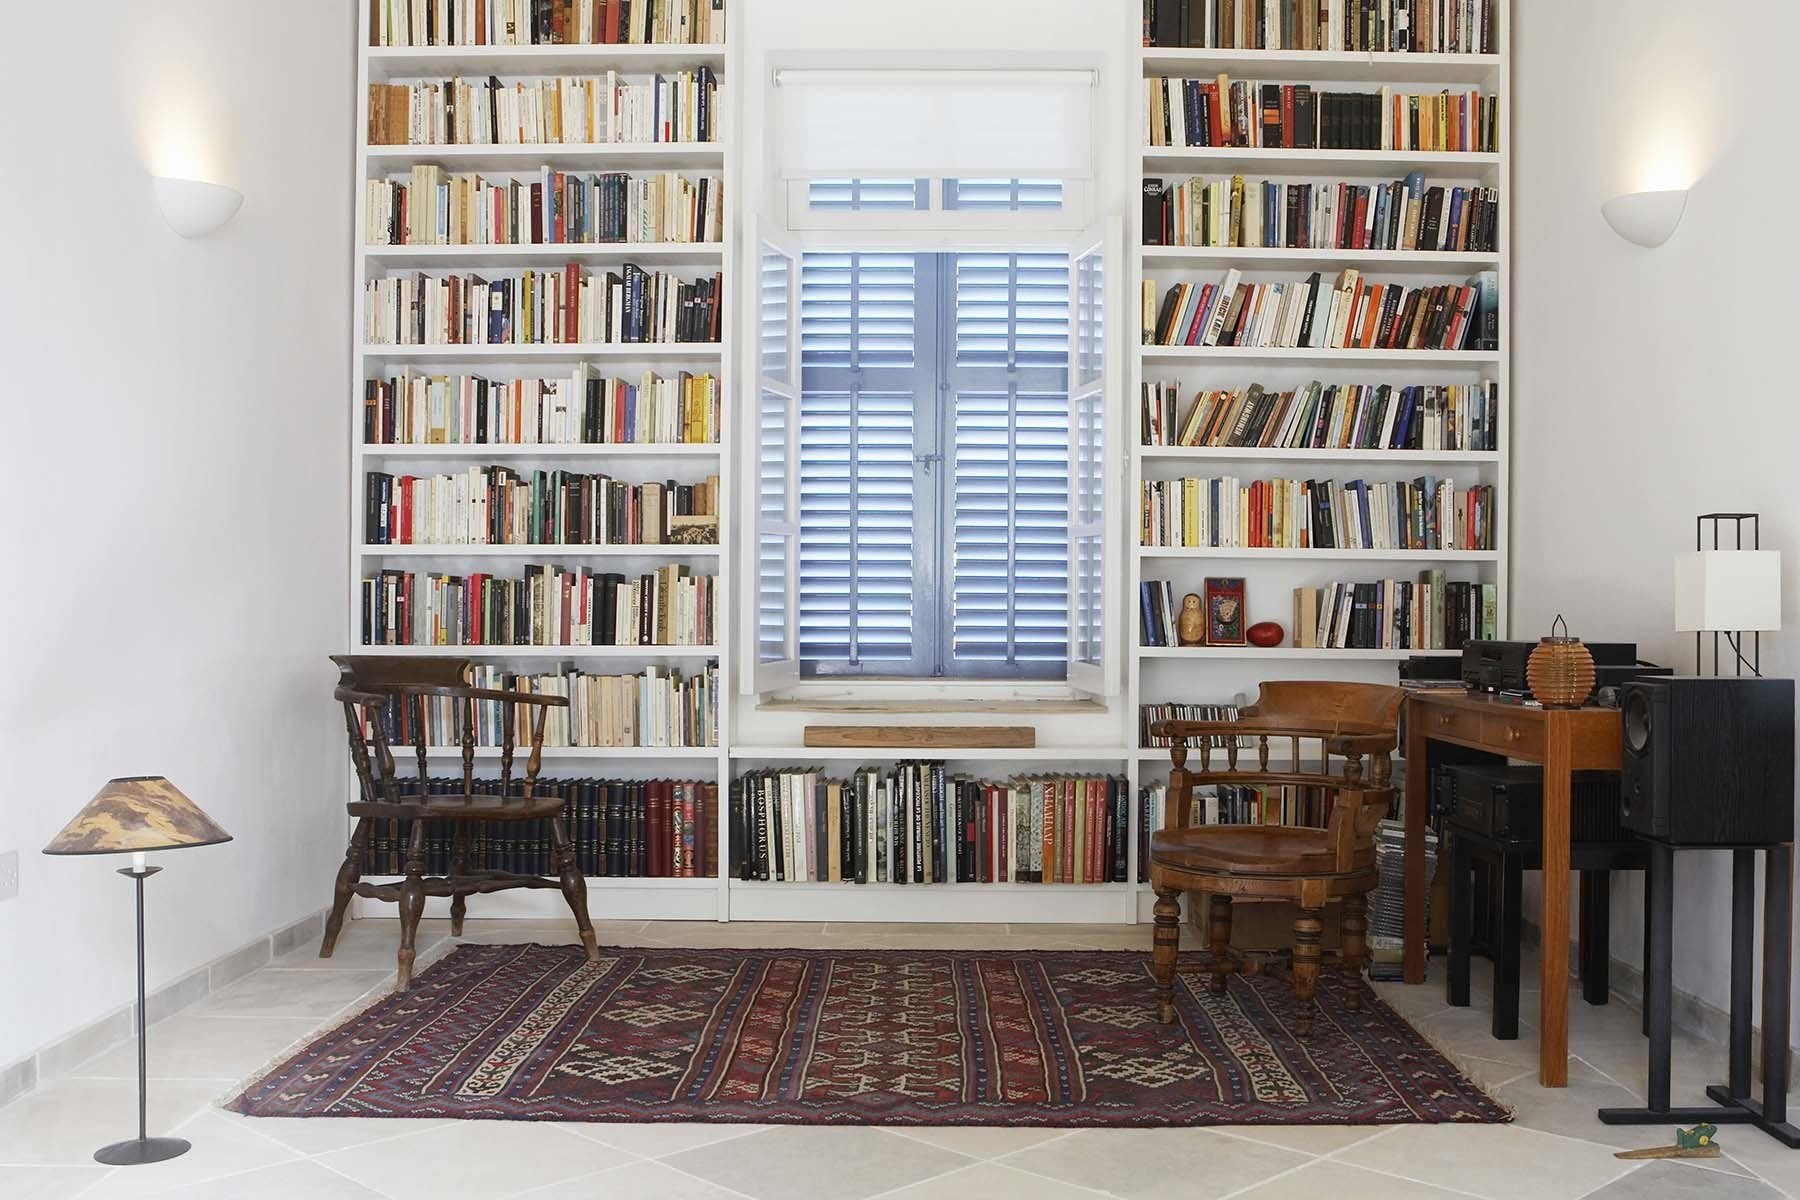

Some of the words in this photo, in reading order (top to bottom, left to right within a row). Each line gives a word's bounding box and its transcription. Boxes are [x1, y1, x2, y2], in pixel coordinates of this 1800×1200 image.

[1217, 295, 1231, 314] BRICK
[1211, 315, 1224, 338] LANE
[1234, 400, 1255, 436] HEMINGWAY
[757, 790, 767, 859] BOSPHORUS
